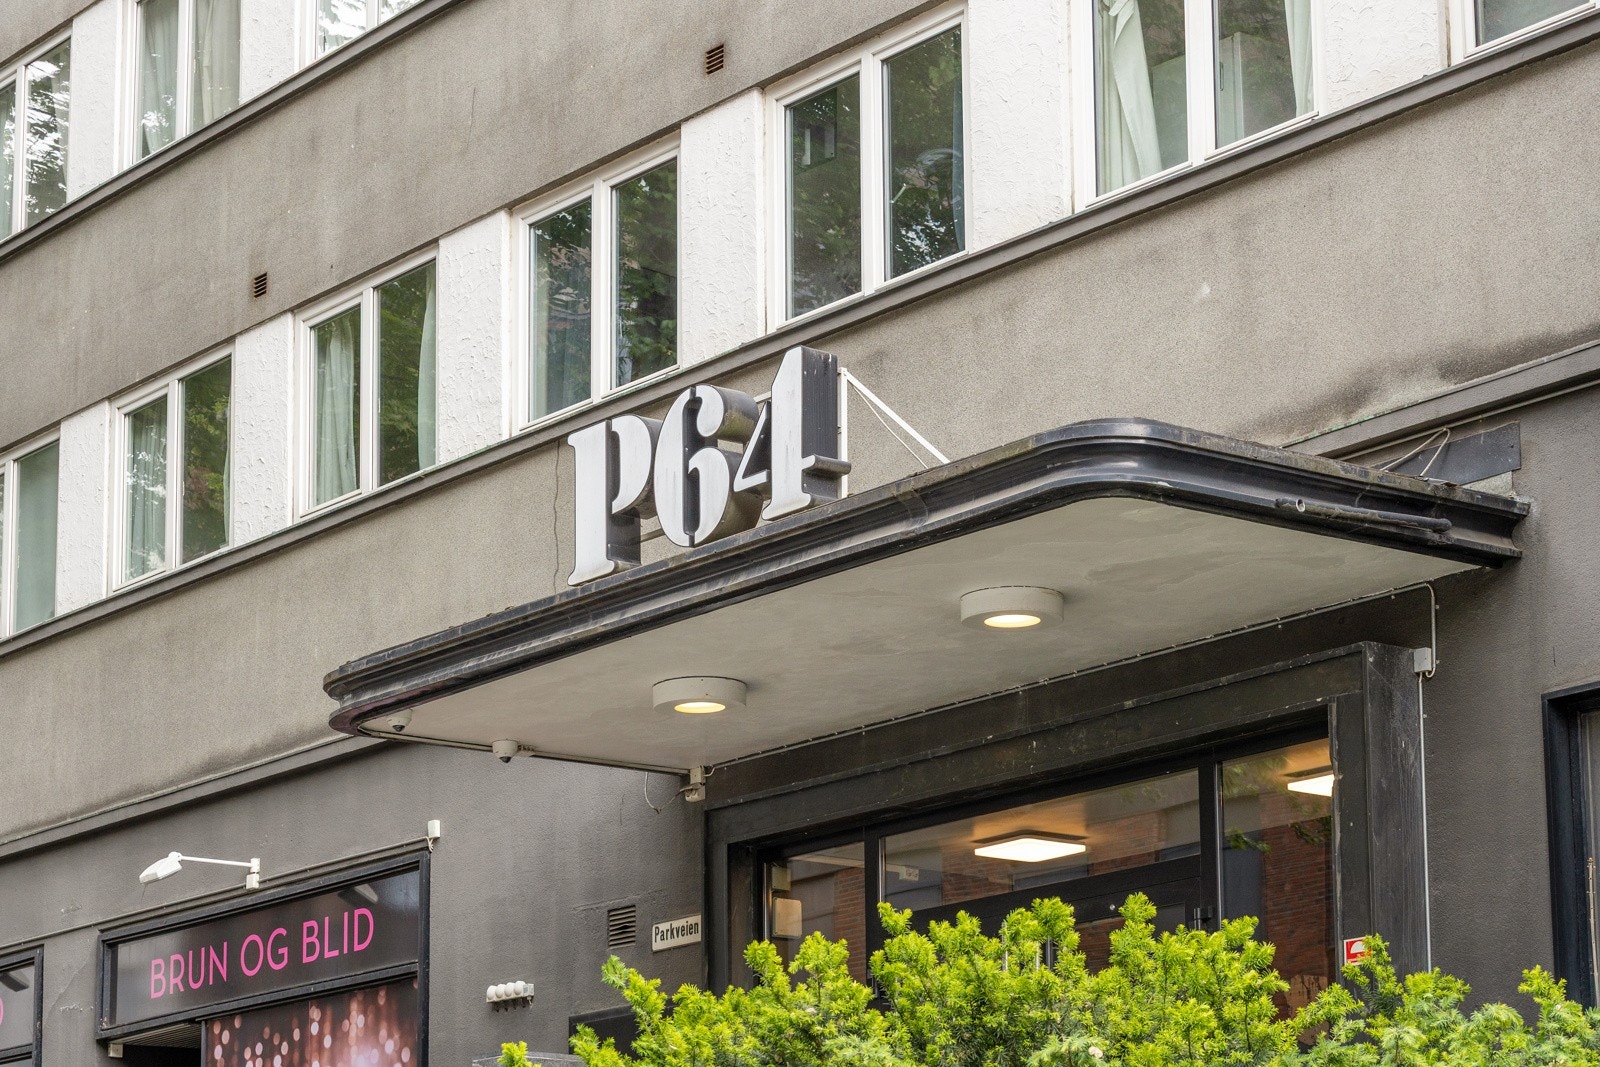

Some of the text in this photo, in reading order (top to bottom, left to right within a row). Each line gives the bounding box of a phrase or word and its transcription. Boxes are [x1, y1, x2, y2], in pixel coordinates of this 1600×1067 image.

[567, 345, 818, 586] P64
[150, 907, 375, 999] BRUN OG BLID
[654, 921, 699, 943] Parkveien
